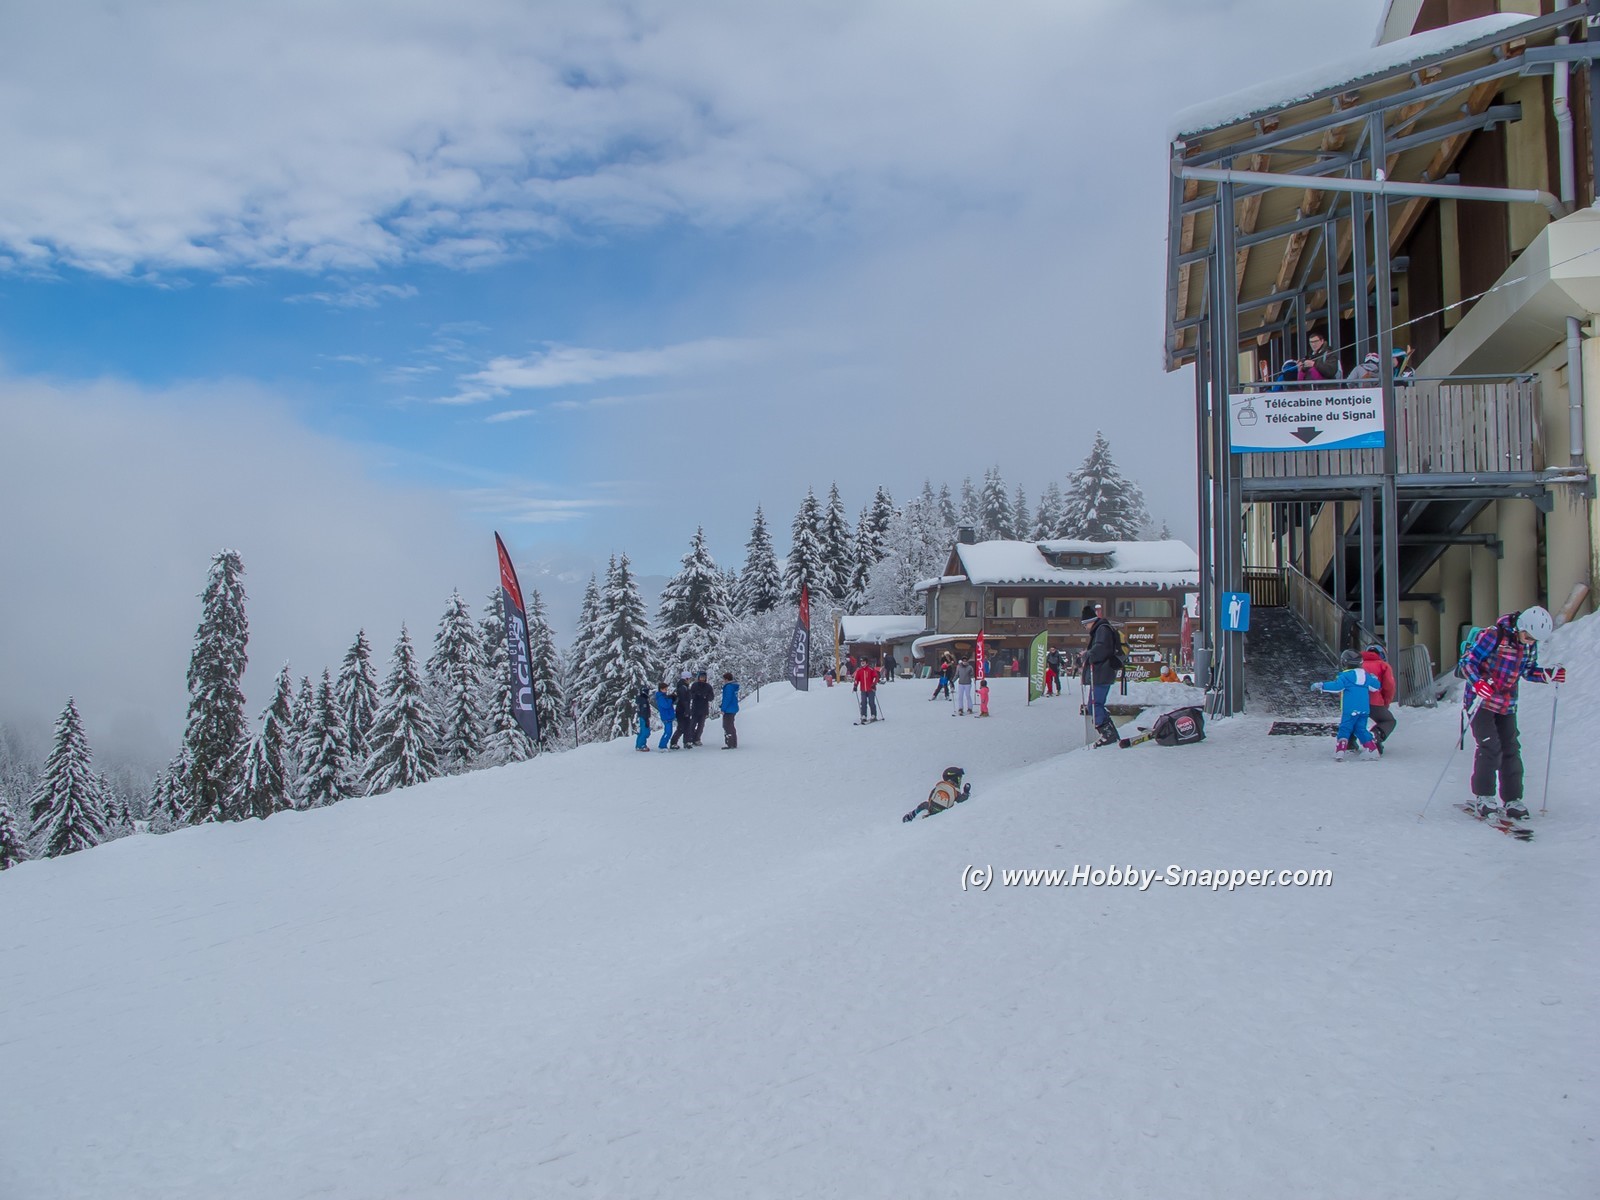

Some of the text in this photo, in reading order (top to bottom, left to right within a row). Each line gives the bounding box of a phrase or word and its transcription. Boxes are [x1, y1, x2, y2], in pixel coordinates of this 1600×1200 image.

[1265, 395, 1372, 408] Télécabine Montjoie
[1265, 410, 1376, 423] Télécabine du Signal
[1035, 644, 1045, 691] BOUTIQUE
[1030, 674, 1037, 684] LA
